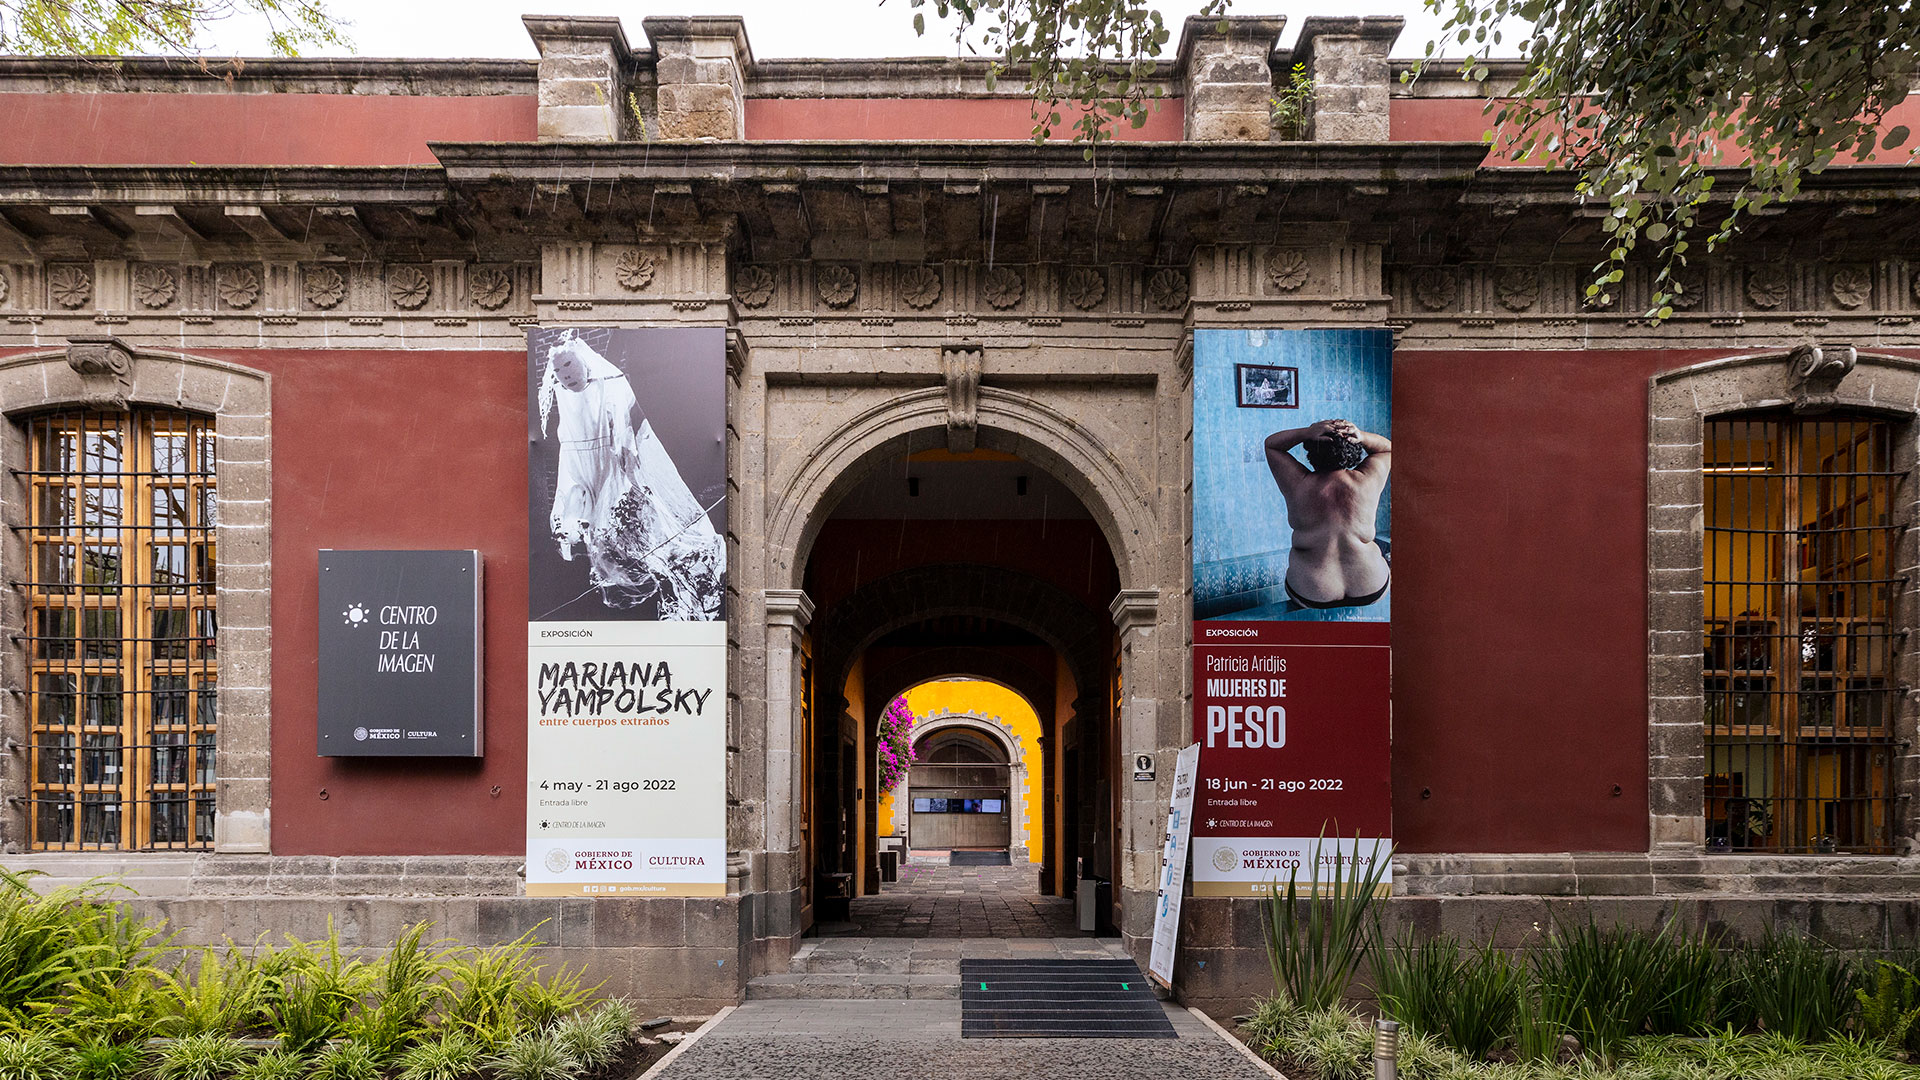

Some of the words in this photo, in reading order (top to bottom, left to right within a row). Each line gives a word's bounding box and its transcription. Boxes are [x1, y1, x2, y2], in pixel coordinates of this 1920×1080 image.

[379, 606, 437, 624] CENTRO
[541, 629, 593, 638] EXPOSICIÓN
[1206, 628, 1258, 637] EXPOSICIÓN
[379, 631, 399, 650] DE
[402, 631, 420, 650] LA
[378, 653, 435, 672] IMAGEN
[1206, 655, 1249, 672] Patricia
[1251, 656, 1287, 674] Aridjis
[538, 661, 673, 691] MARIANA
[1207, 678, 1267, 698] MUJERES
[1270, 679, 1287, 698] DE
[538, 688, 712, 717] YAMPOLSKY
[539, 718, 569, 726] entre
[572, 718, 617, 728] cuerpos
[620, 716, 670, 726] extraños
[1207, 705, 1286, 749] PESO
[540, 780, 549, 790] 4
[553, 782, 583, 793] may
[596, 780, 608, 790] 21
[613, 782, 639, 793] ago
[643, 780, 676, 790] 2022
[1206, 779, 1221, 790] 18
[1223, 778, 1248, 792] jun
[1261, 779, 1274, 790] 21
[1279, 781, 1305, 792] ago
[1309, 779, 1343, 791] 2022
[572, 799, 589, 807] libre
[1207, 799, 1238, 807] Entrada
[1240, 799, 1257, 807] libre
[552, 821, 572, 829] CENTRO
[572, 821, 580, 829] DE
[580, 821, 587, 829] LA
[587, 821, 606, 829] IMAGEN
[1254, 820, 1274, 828] IMAGEN
[575, 858, 633, 870] MÉXICO
[649, 856, 705, 866] CULTURA
[1242, 857, 1300, 869] MÉXICO
[619, 885, 666, 893] gob.mx/cultura
